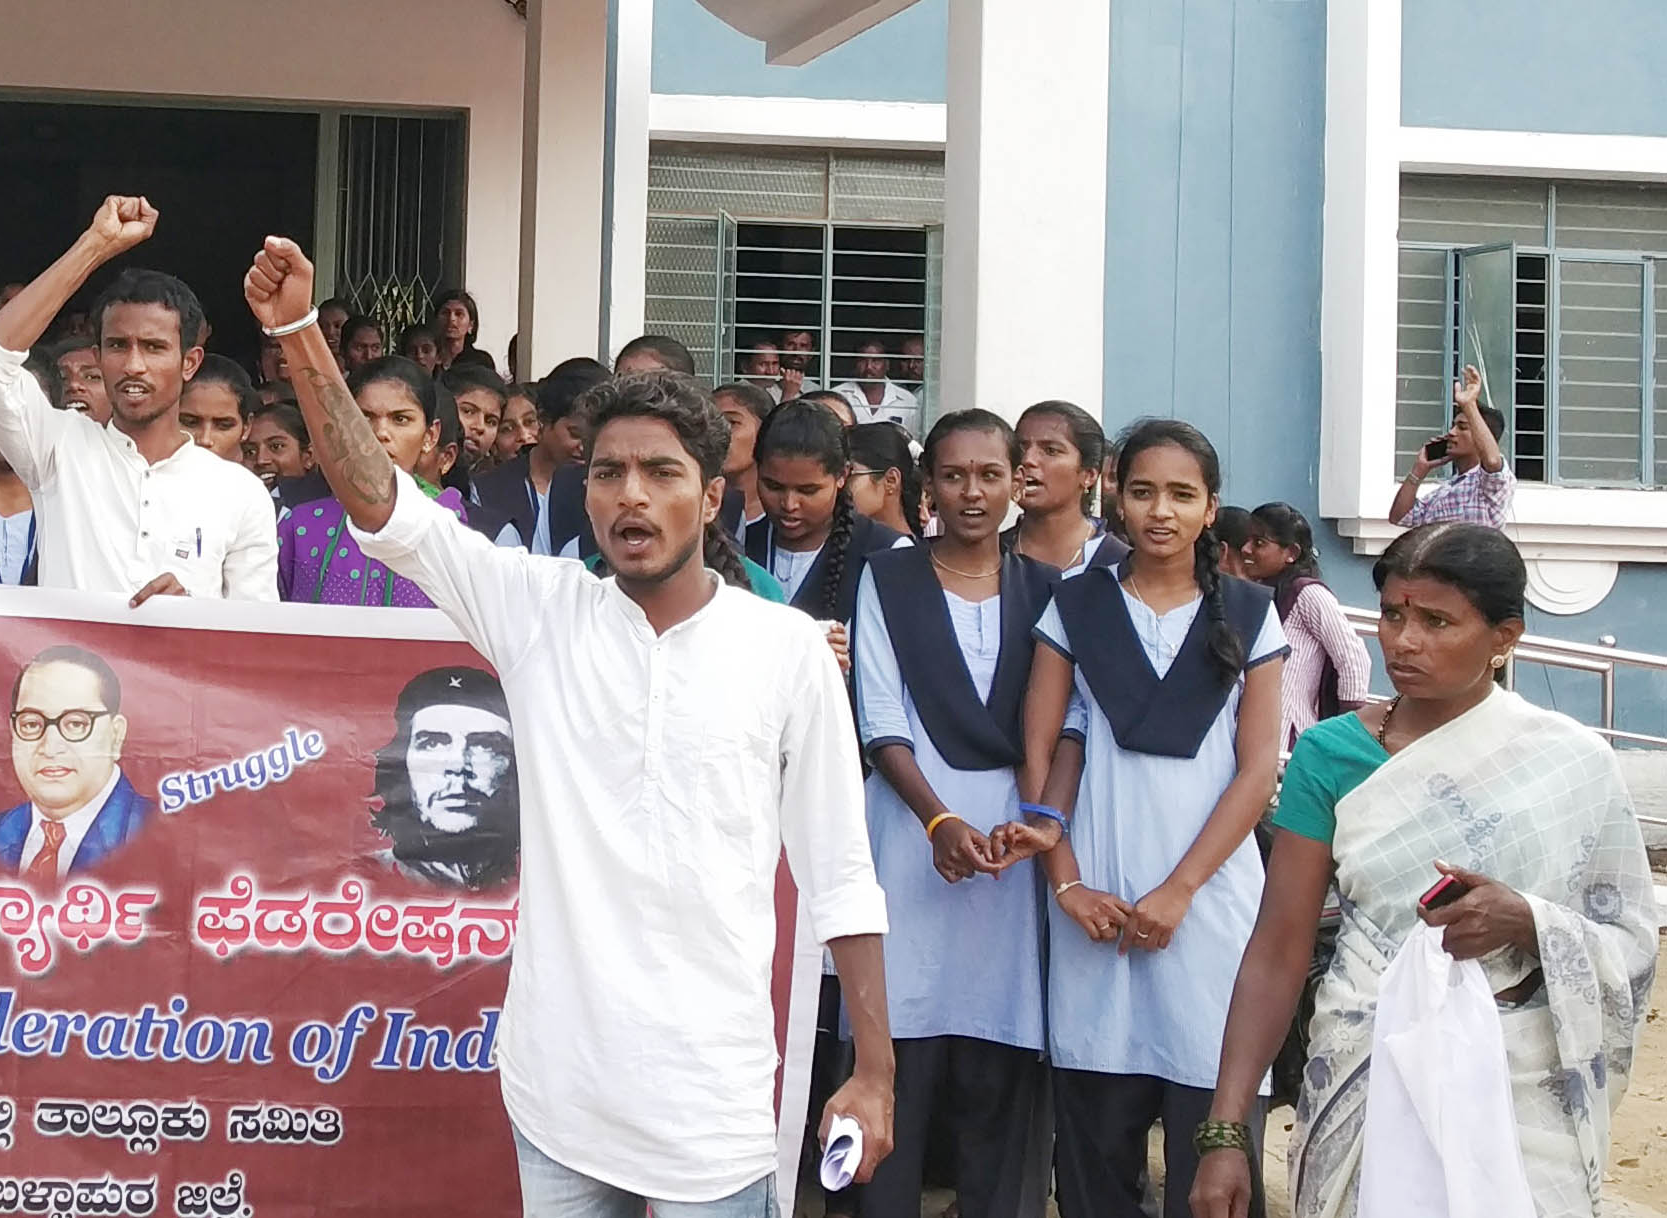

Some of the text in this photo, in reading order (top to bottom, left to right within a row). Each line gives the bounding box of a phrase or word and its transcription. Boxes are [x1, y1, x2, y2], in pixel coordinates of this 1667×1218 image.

[160, 729, 324, 812] Struggle
[292, 1005, 376, 1080] of
[372, 1010, 501, 1070] Ind
[229, 1103, 342, 1142] ಸಮಿತಿ
